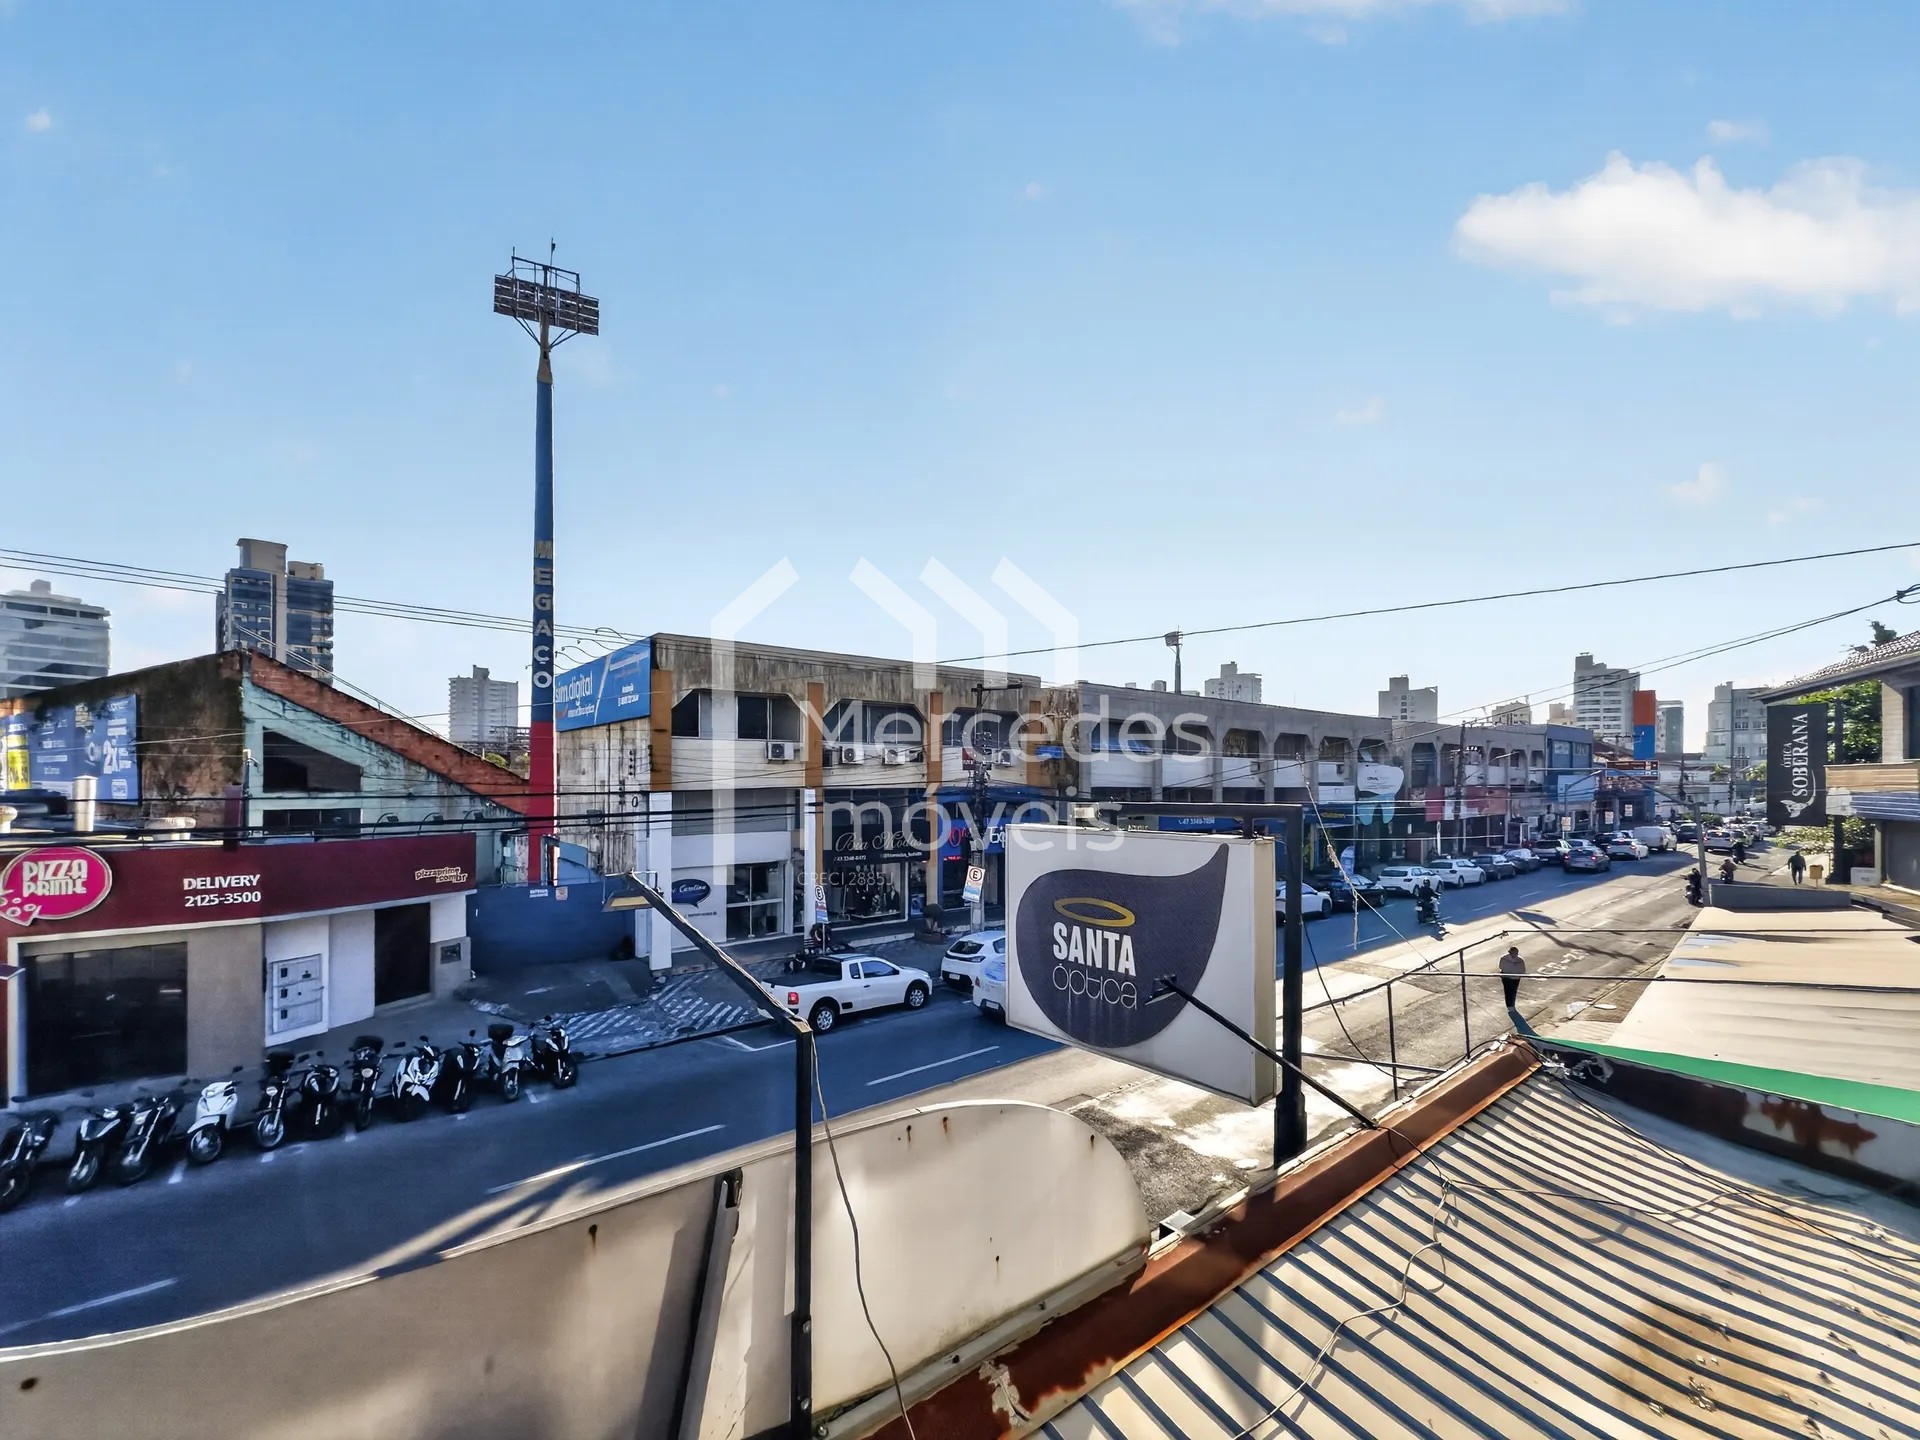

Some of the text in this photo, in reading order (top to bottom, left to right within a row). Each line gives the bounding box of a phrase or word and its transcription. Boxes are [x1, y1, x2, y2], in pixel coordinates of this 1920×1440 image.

[532, 540, 553, 689] MEGAÇO
[1779, 742, 1792, 768] ÓTICA
[1791, 712, 1809, 797] SOBERANA
[872, 830, 923, 850] Modas
[22, 859, 88, 881] PIZZA
[22, 878, 88, 897] PRIME
[183, 873, 261, 891] DELIVERY
[184, 891, 262, 907] 2125-3500
[1052, 921, 1137, 977] SANTA
